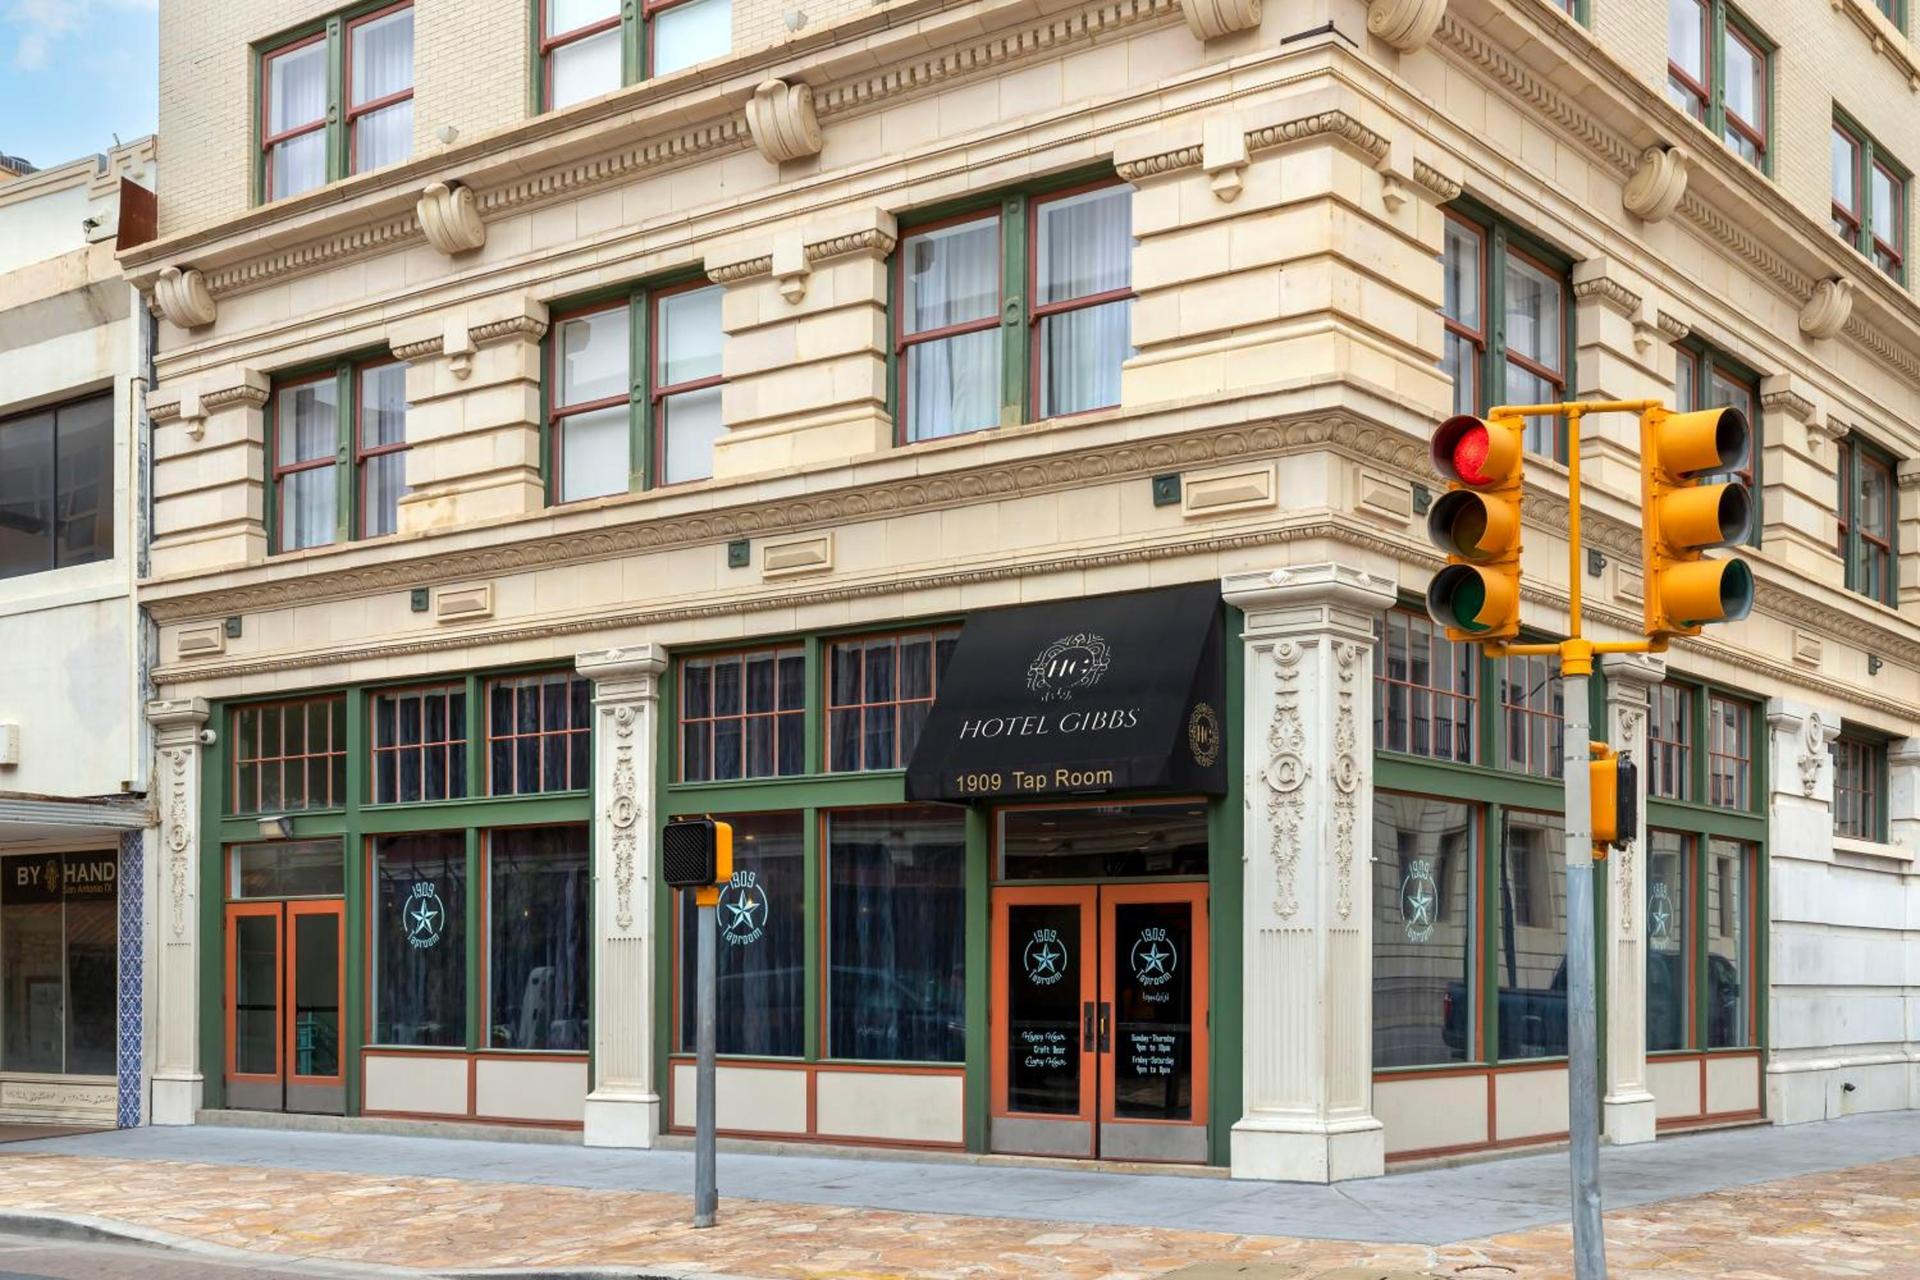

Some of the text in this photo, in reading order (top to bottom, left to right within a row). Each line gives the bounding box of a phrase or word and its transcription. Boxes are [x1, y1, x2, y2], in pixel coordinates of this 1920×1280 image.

[959, 709, 1138, 740] HOTEL GIBBS
[956, 769, 1113, 793] 1909 Tap Room
[17, 862, 116, 886] BY HAND
[411, 882, 435, 899] 1909
[1033, 929, 1057, 943] 1909
[1141, 927, 1166, 942] 1909
